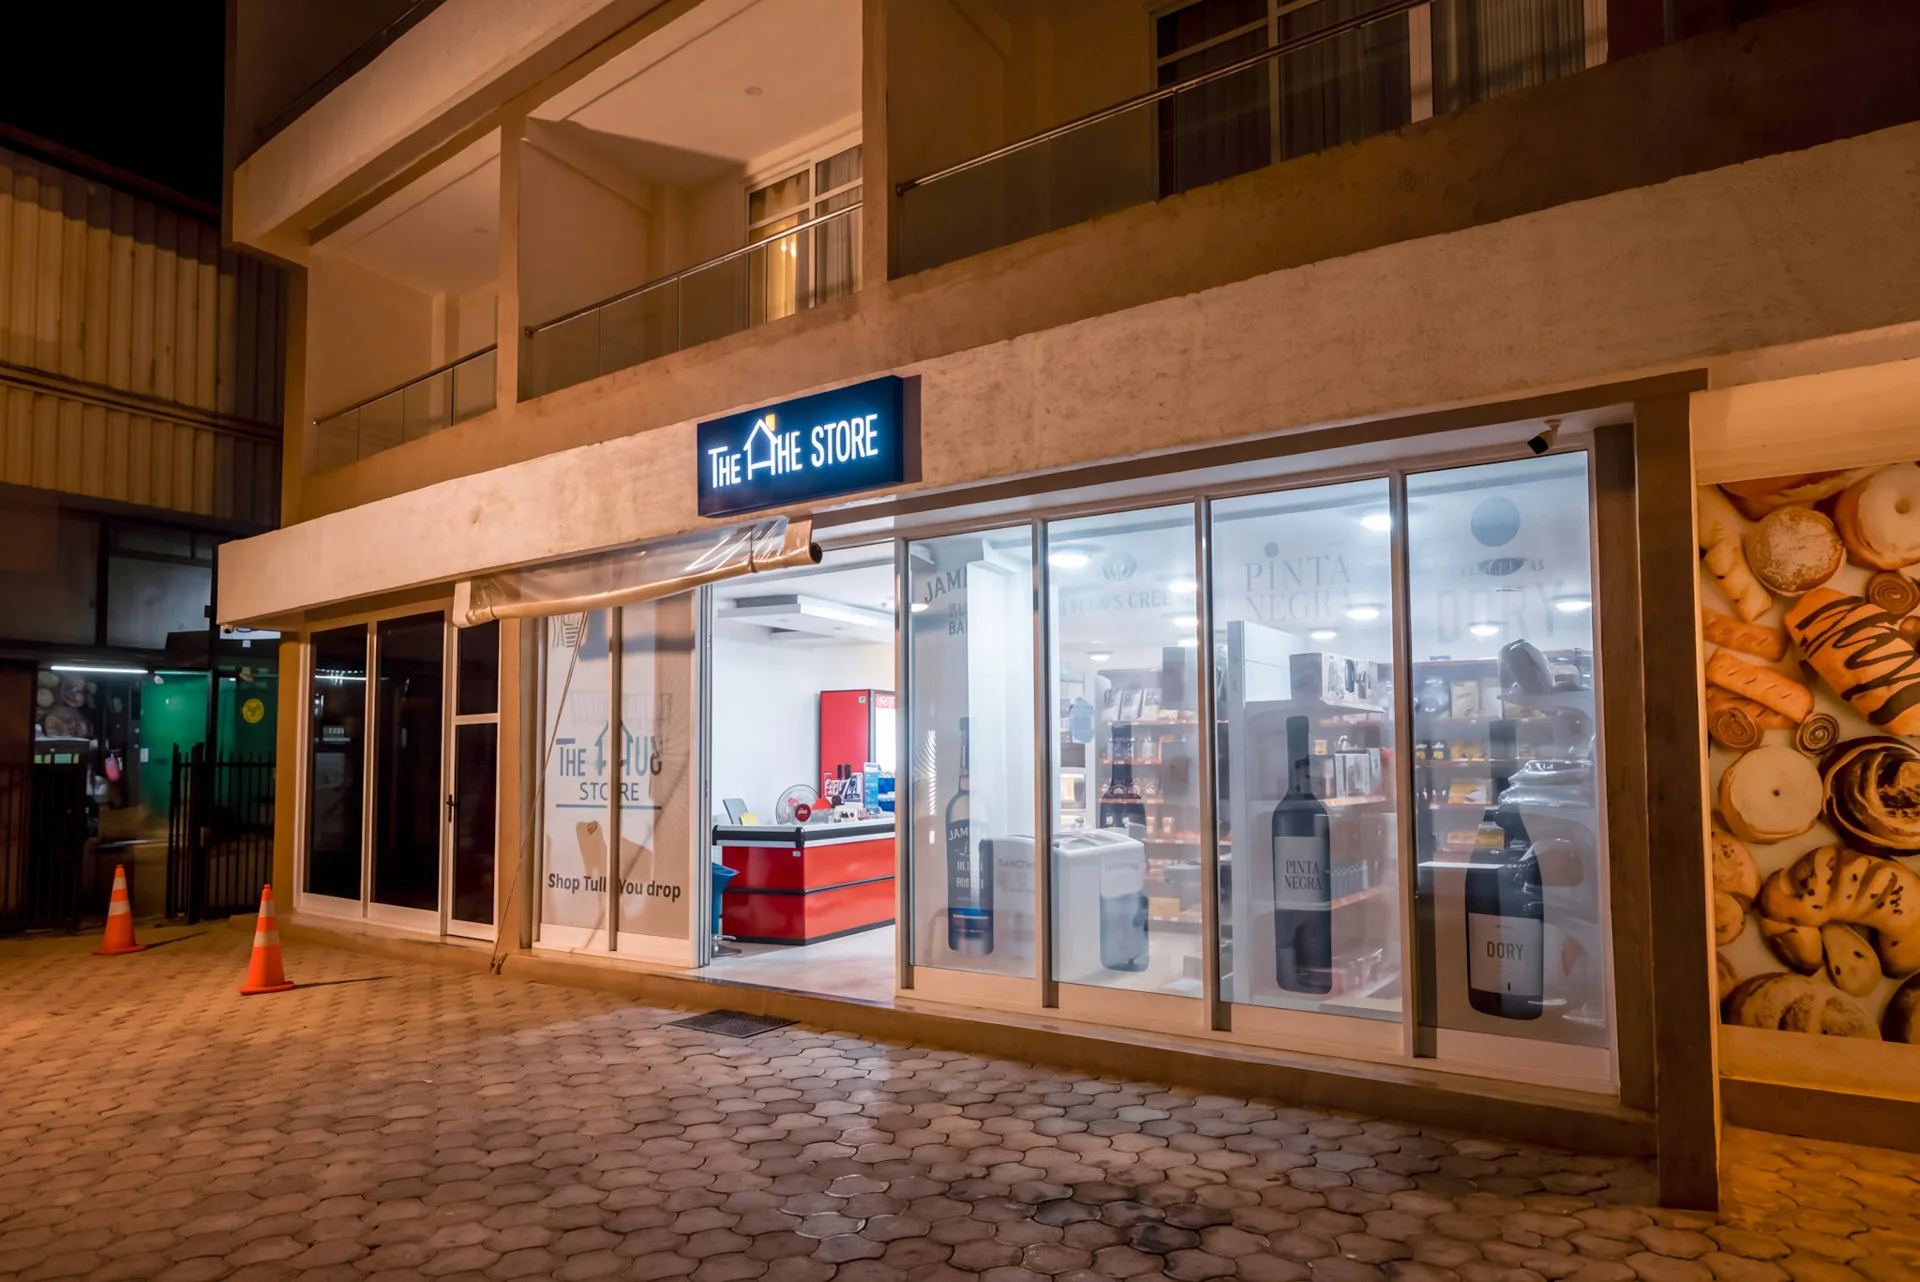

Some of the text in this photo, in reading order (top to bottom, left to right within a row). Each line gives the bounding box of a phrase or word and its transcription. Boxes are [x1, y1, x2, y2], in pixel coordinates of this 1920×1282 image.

[811, 414, 878, 467] STORE
[1245, 552, 1353, 593] PINTA
[556, 738, 586, 776] THE
[1286, 860, 1320, 874] PINTA
[548, 873, 580, 895] Shop
[618, 878, 643, 896] You
[647, 880, 682, 903] drop
[1284, 875, 1323, 891] NEGRA
[1486, 940, 1524, 961] DORY
